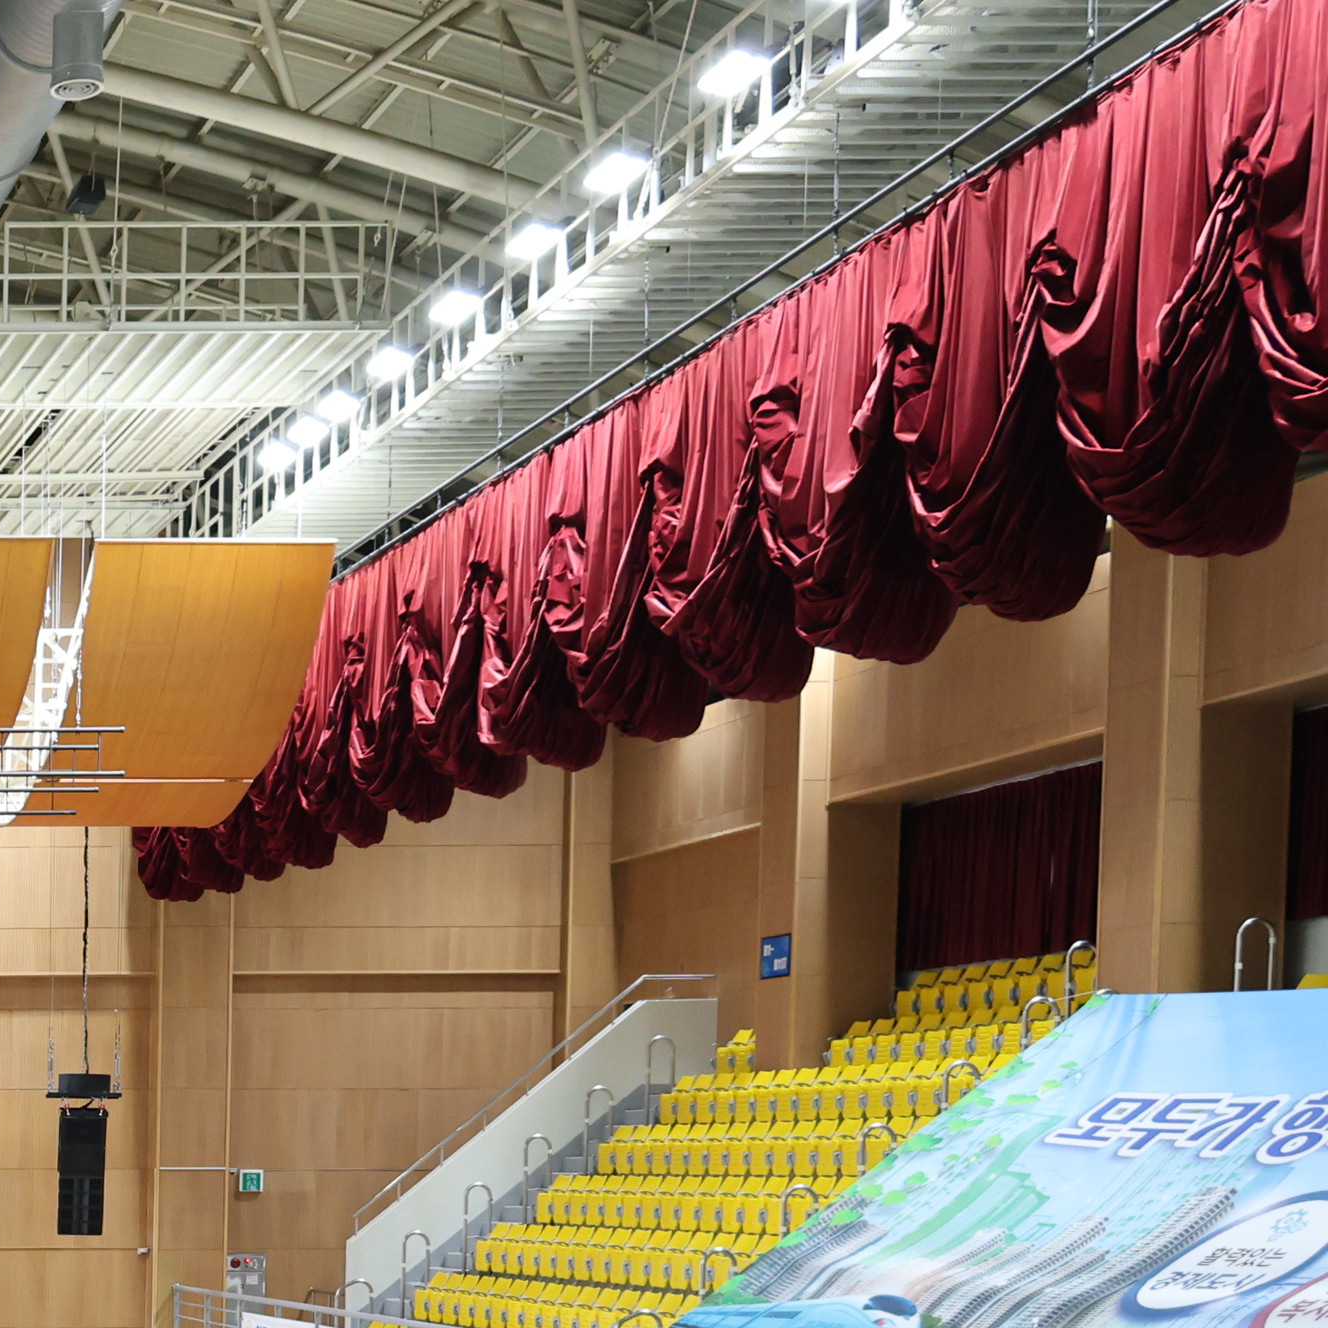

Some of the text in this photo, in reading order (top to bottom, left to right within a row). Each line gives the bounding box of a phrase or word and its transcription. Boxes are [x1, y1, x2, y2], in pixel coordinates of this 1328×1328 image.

[1055, 1096, 1281, 1152] 모두가
[1197, 1246, 1287, 1268] 활력있는
[1150, 1270, 1266, 1291] 경제도시
